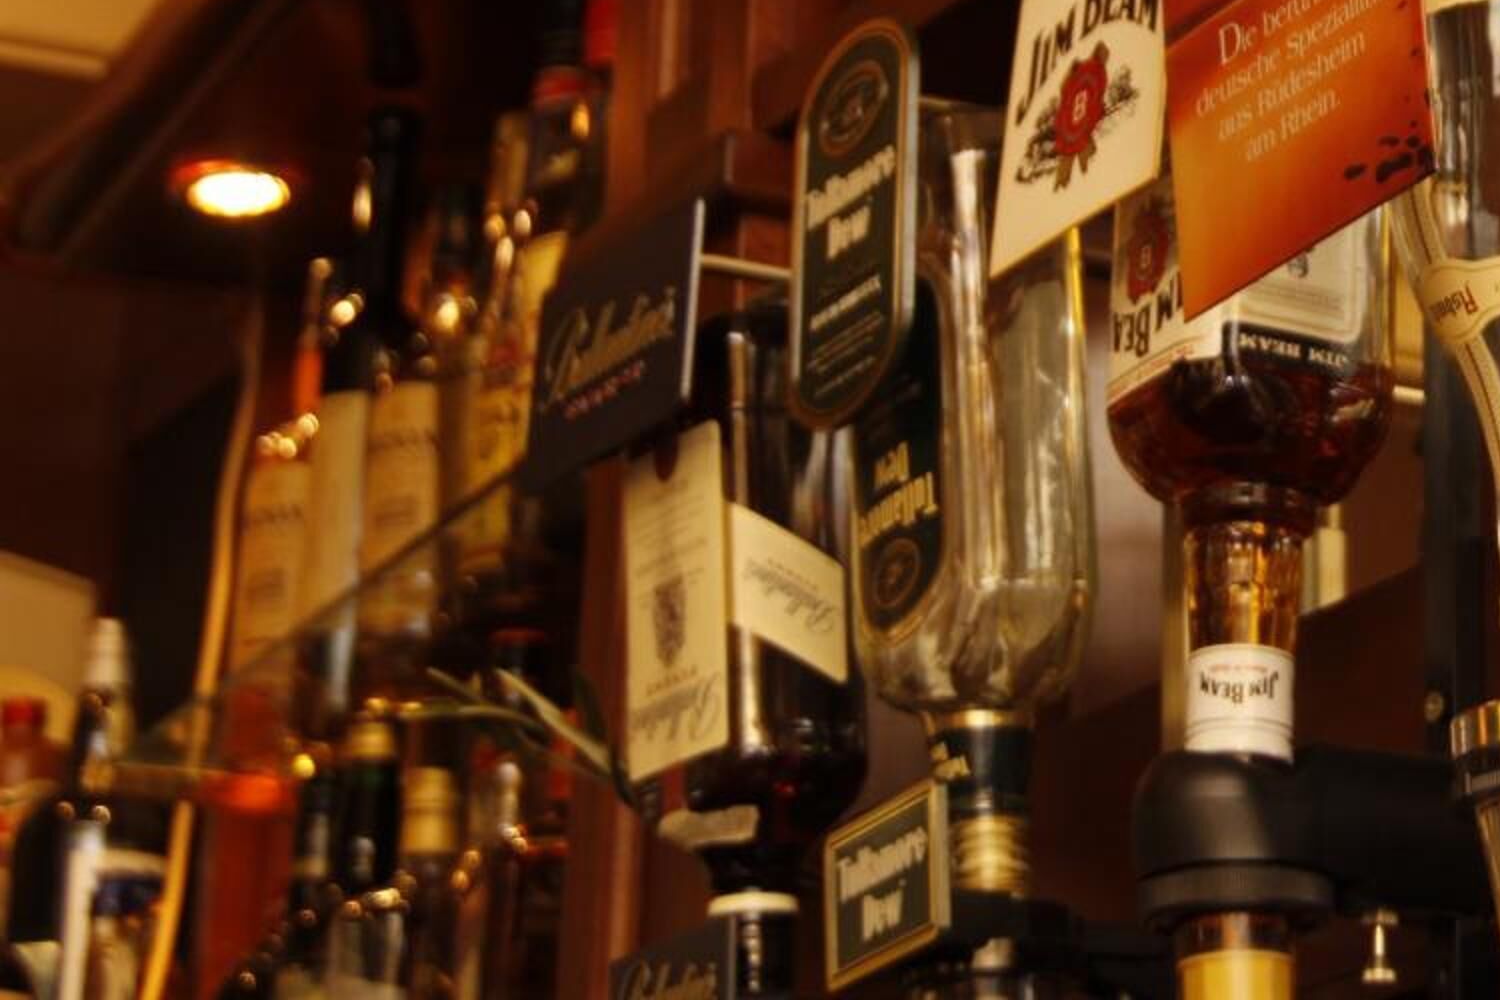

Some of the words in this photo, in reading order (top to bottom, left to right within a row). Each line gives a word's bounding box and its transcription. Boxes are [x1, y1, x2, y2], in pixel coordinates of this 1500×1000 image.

[1015, 7, 1076, 127] JIM
[1219, 22, 1258, 66] Die
[1195, 47, 1281, 118] deutsche
[1218, 102, 1253, 141] aus
[1256, 31, 1366, 117] Rüdesheim
[1246, 127, 1276, 161] am
